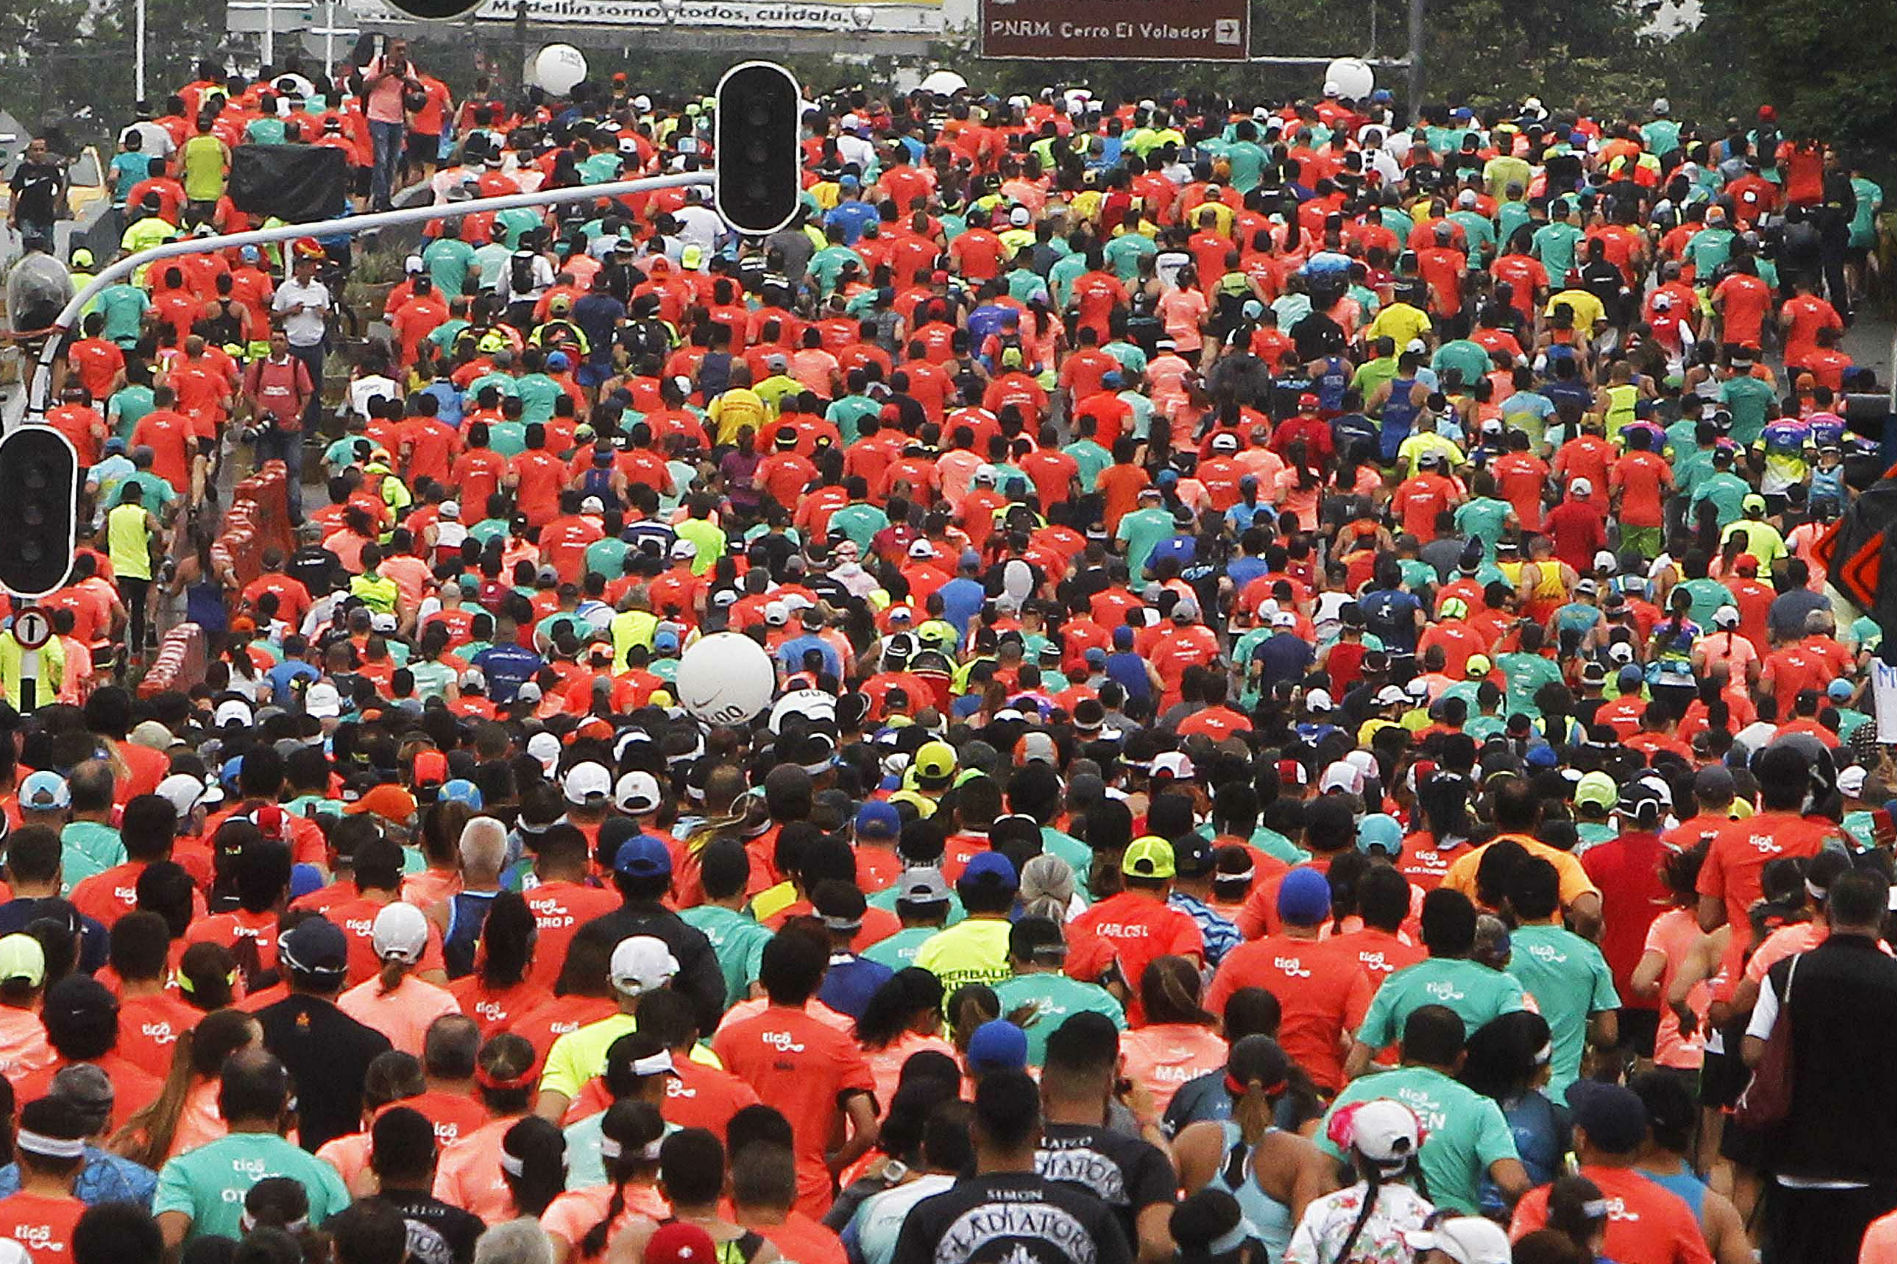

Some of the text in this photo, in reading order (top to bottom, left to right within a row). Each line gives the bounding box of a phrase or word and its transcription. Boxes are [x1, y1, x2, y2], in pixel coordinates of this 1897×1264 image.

[678, 7, 751, 23] todos,
[1060, 22, 1110, 38] Cerro
[1115, 22, 1133, 38] El
[1139, 23, 1210, 39] Volador
[986, 1189, 1044, 1203] SIMON
